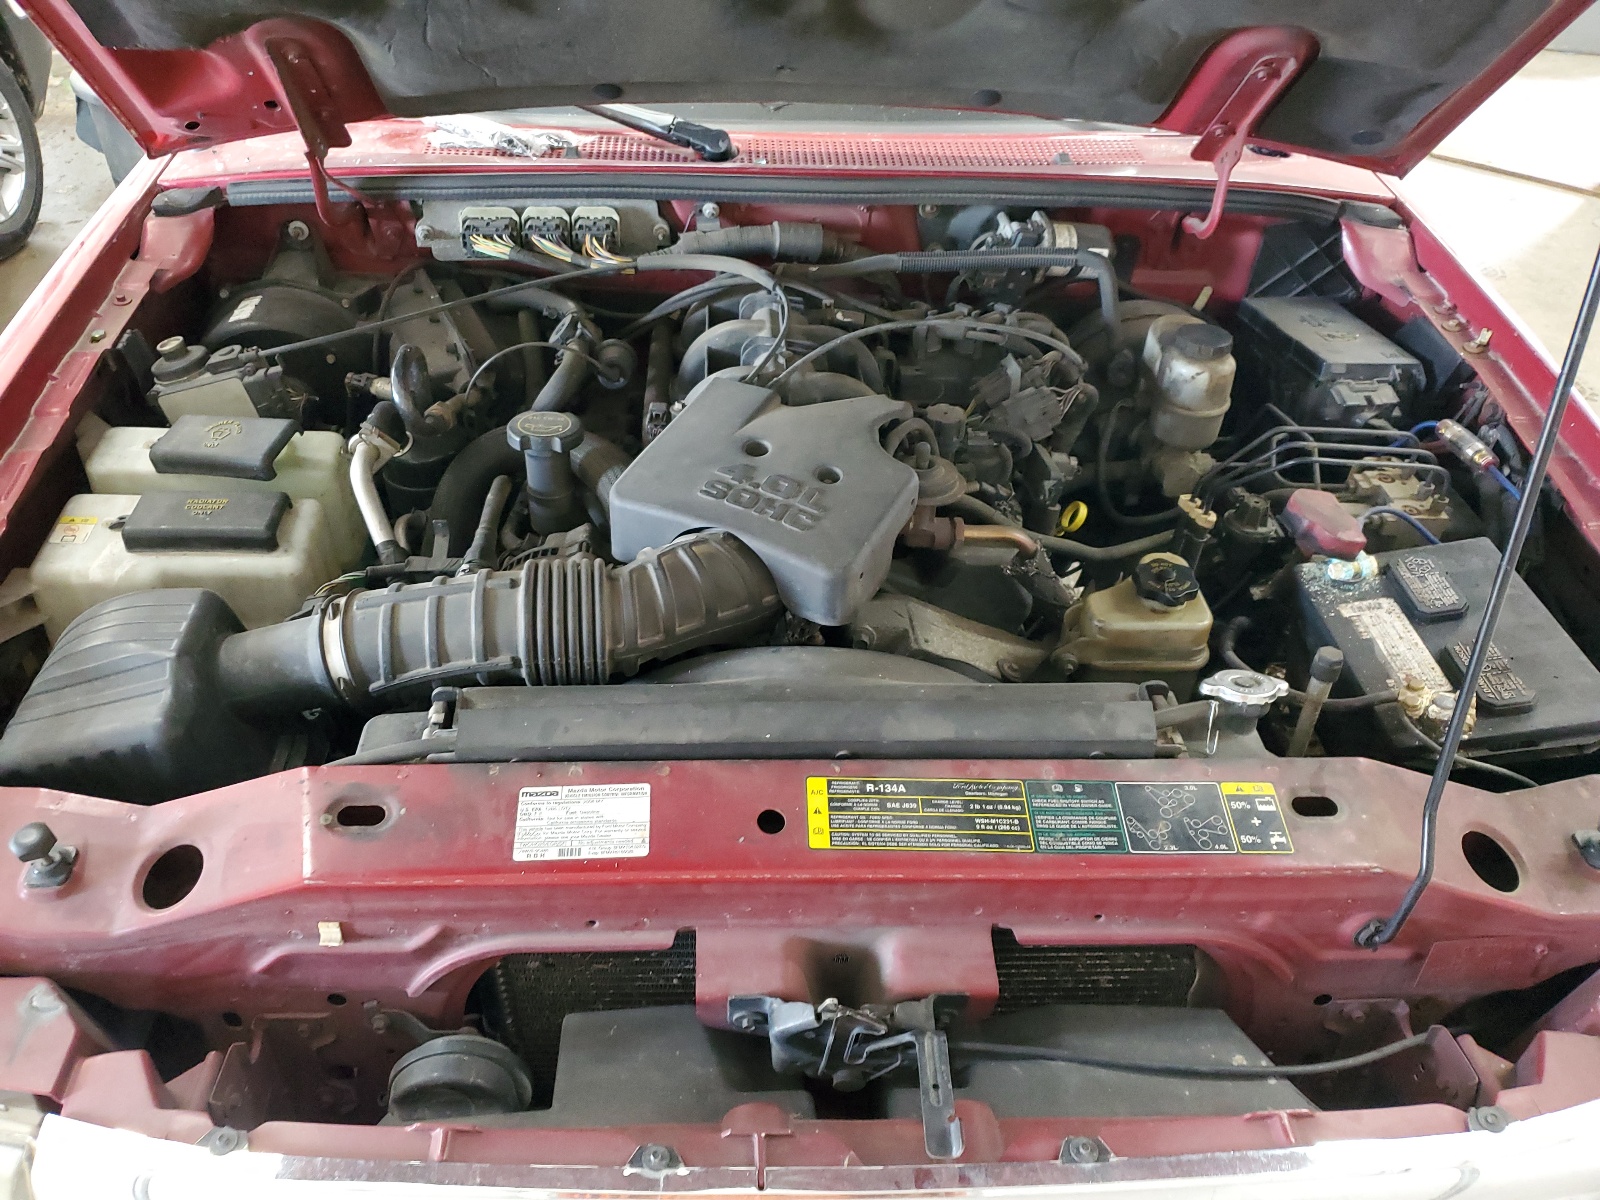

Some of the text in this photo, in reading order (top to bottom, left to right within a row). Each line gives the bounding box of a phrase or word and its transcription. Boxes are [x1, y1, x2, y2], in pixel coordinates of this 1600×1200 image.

[714, 463, 829, 514] 4.0L
[697, 479, 821, 533] SOHC
[866, 783, 907, 793] R-134A
[521, 790, 559, 798] mazda
[1230, 801, 1251, 810] 50%
[1240, 835, 1262, 844] 50%
